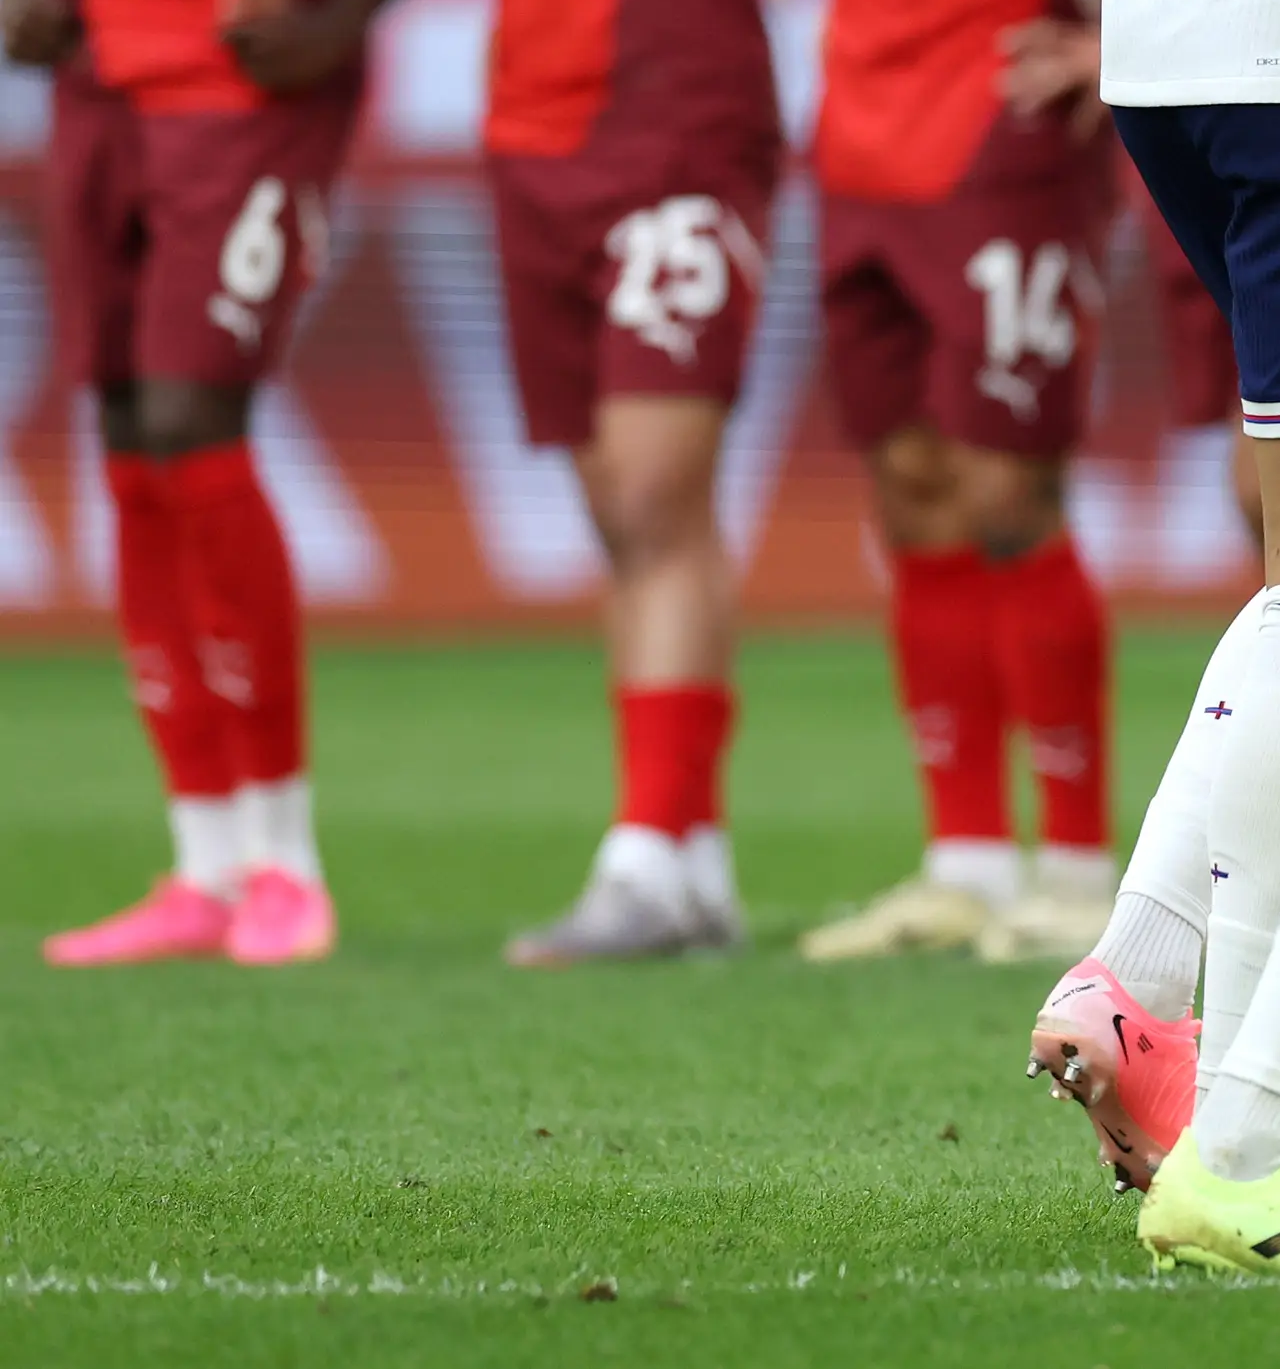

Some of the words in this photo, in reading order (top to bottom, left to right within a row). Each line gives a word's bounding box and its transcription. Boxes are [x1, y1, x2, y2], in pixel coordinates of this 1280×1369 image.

[220, 174, 287, 304] 6
[604, 194, 731, 328] 25
[963, 236, 1077, 370] 14
